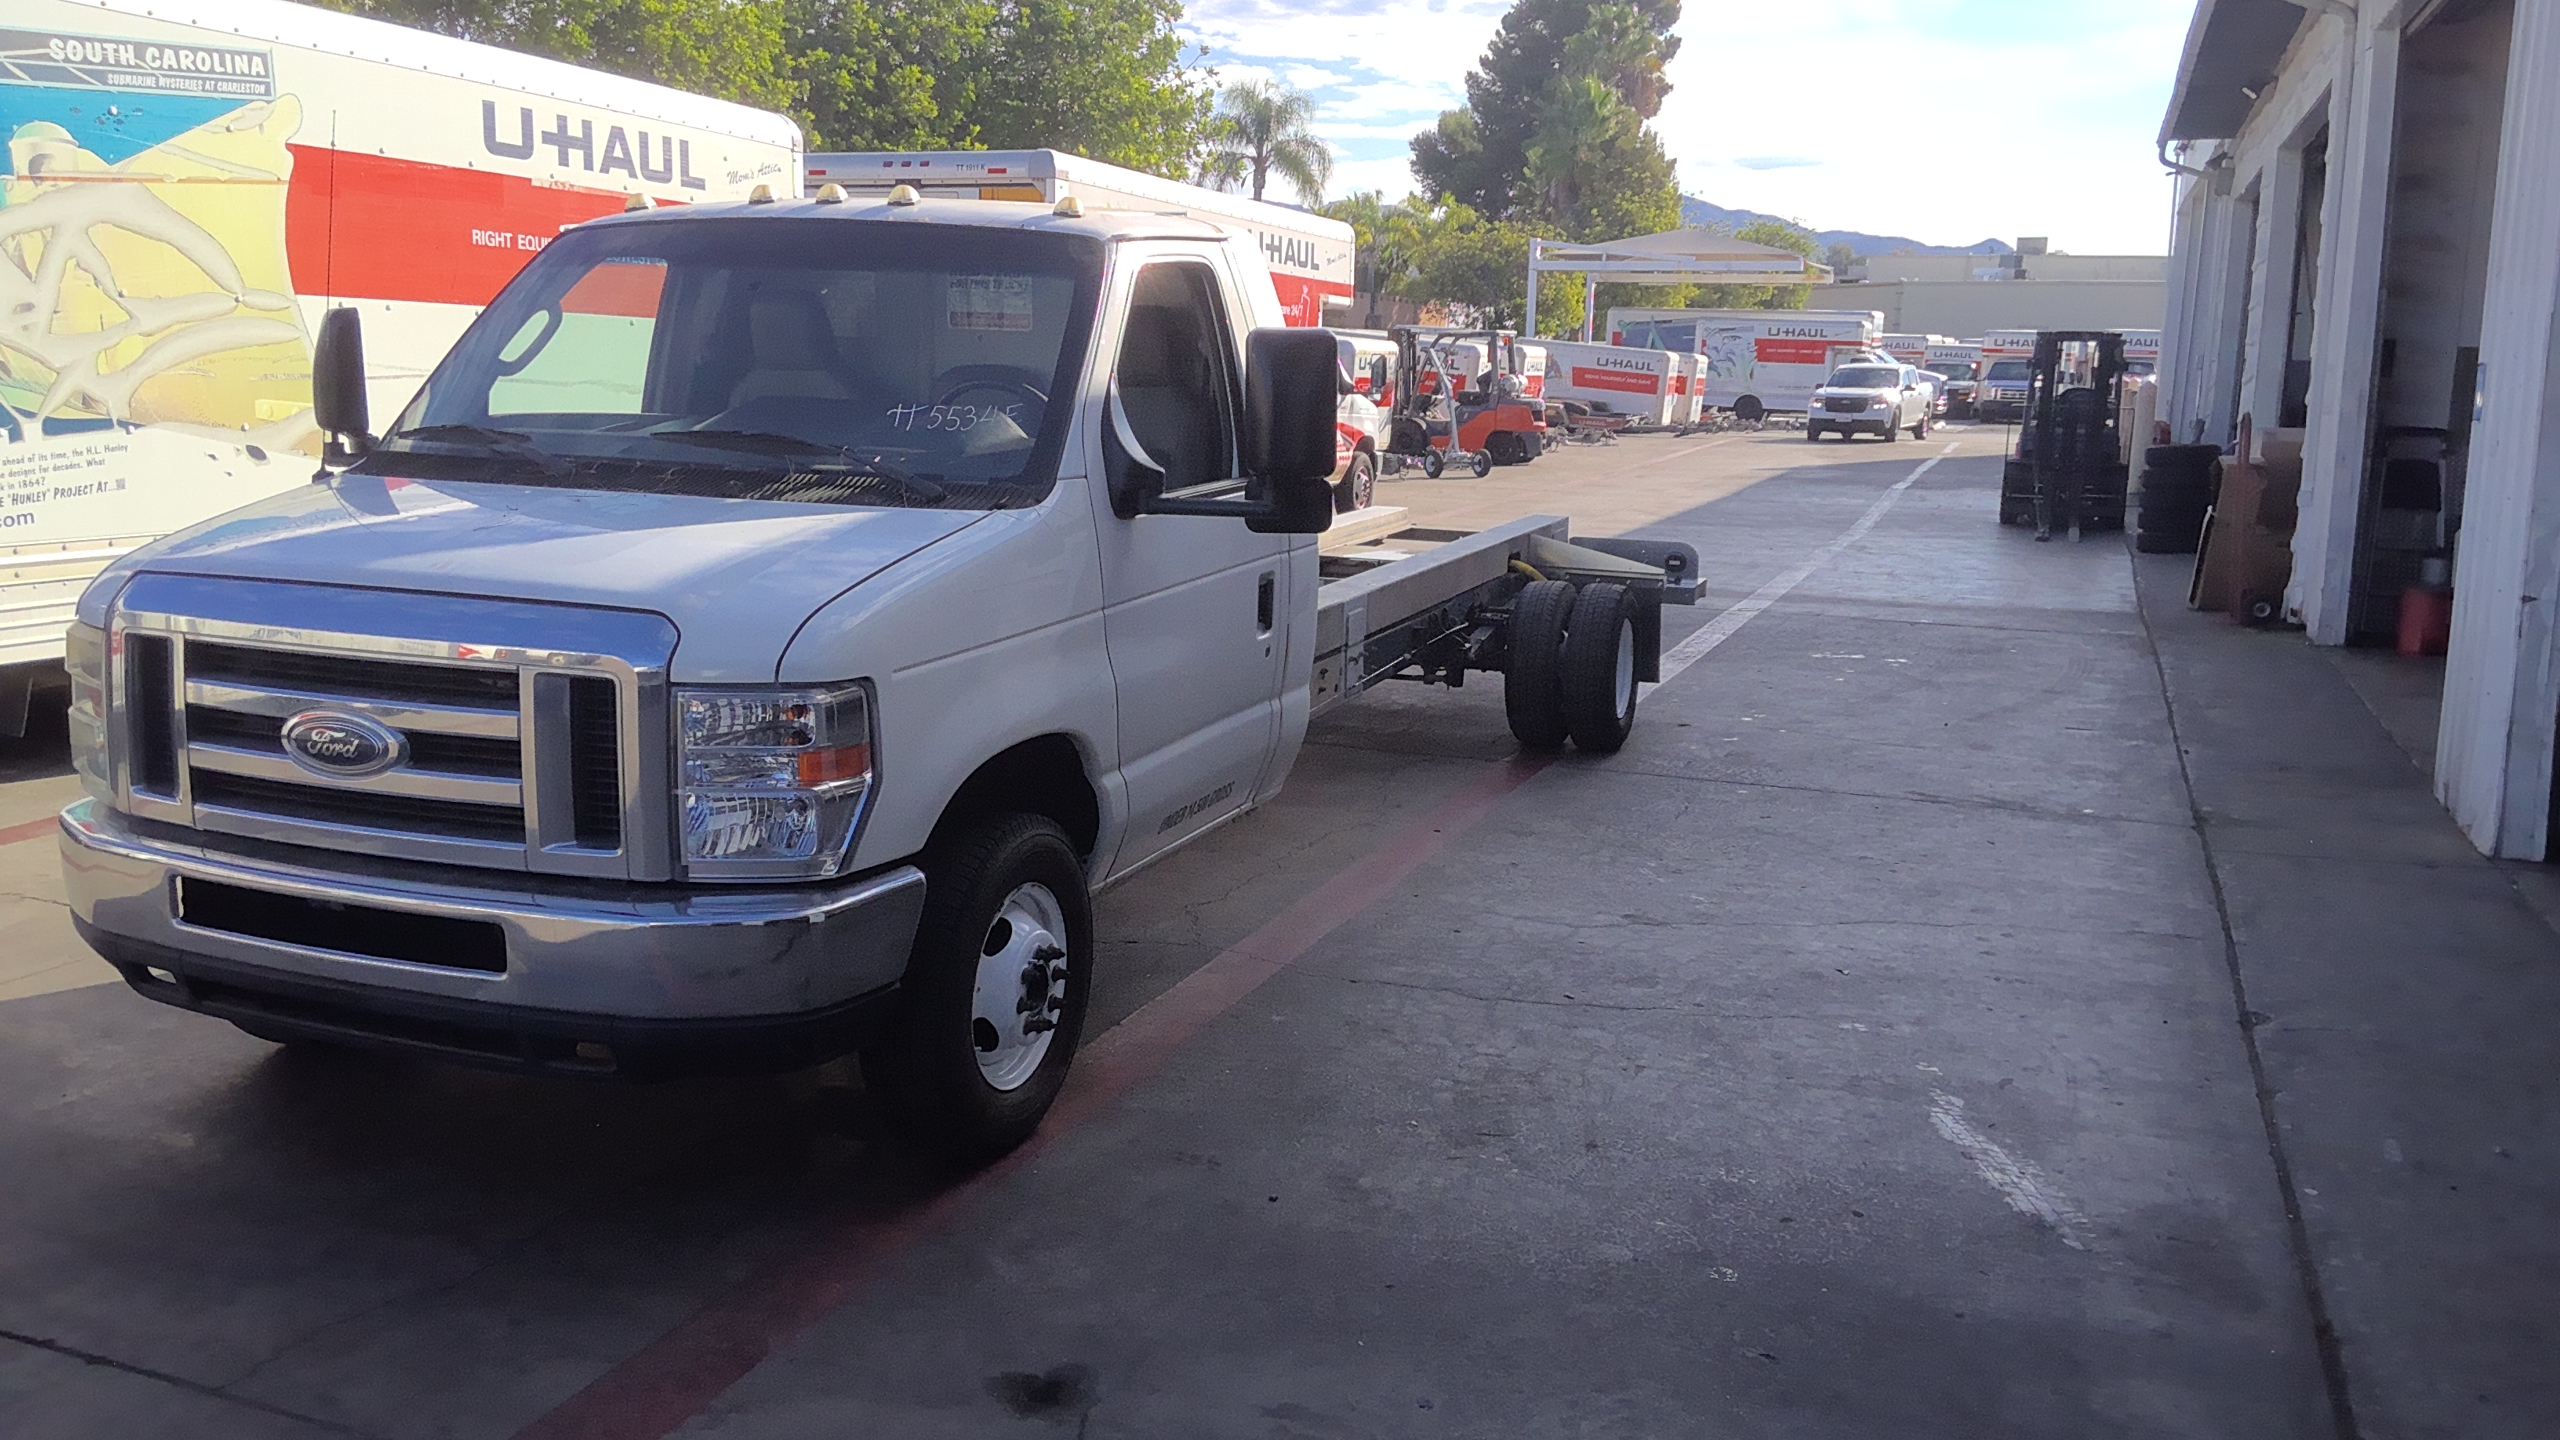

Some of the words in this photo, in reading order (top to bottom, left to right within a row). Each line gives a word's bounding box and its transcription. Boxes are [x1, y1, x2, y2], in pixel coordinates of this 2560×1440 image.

[49, 38, 136, 66] SOUTH
[145, 46, 266, 76] CAROLINA
[107, 73, 157, 88] SUBMARINE
[158, 74, 203, 91] MYSTERIES
[204, 80, 215, 91] AT
[216, 81, 266, 95] CHARLESTON
[471, 229, 513, 248] RIGHT
[27, 453, 36, 463] of
[38, 453, 48, 461] its
[72, 448, 84, 457] the
[8, 468, 36, 478] designs
[39, 464, 50, 474] for
[86, 458, 105, 467] What
[7, 481, 15, 490] in
[18, 477, 46, 489] 1864?
[53, 483, 94, 500] PROJECT
[307, 728, 360, 758] Ford
